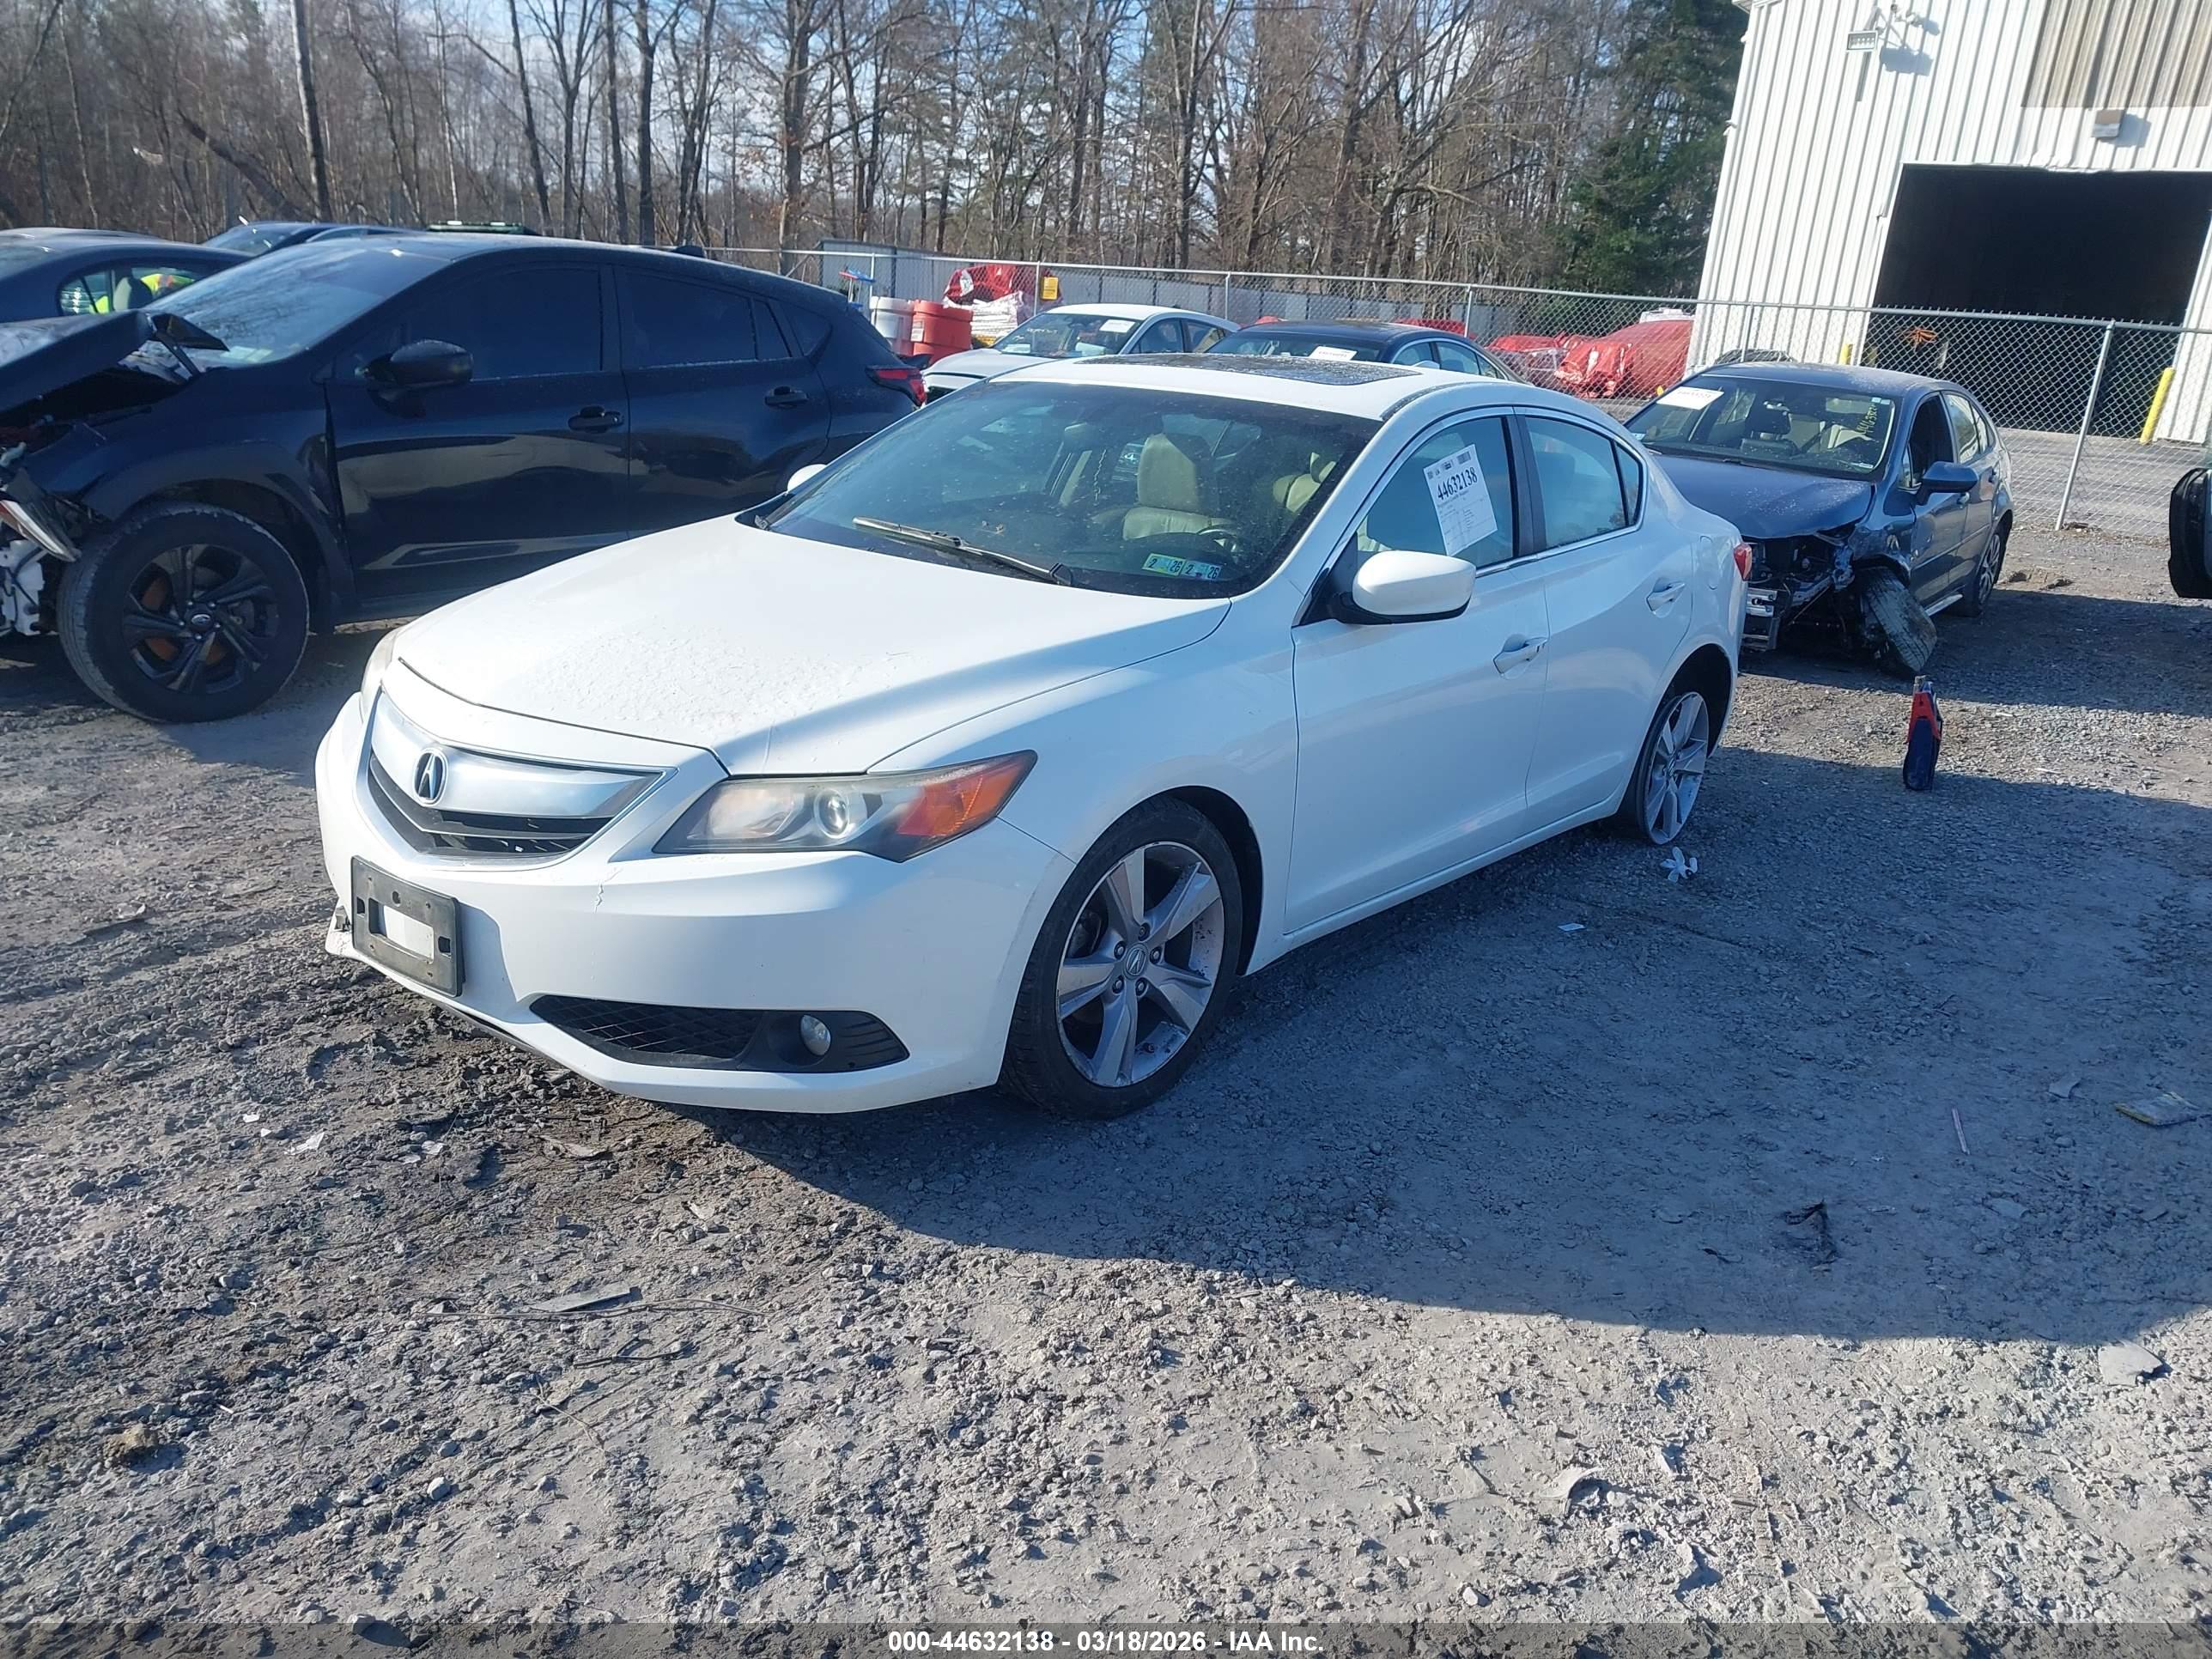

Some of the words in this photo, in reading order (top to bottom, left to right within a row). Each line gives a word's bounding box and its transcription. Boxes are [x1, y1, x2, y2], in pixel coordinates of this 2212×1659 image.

[1437, 466, 1477, 500] 44632138
[1148, 558, 1158, 568] 2
[1170, 560, 1182, 573] 26
[1185, 564, 1194, 574] 2
[1207, 567, 1219, 580] 26
